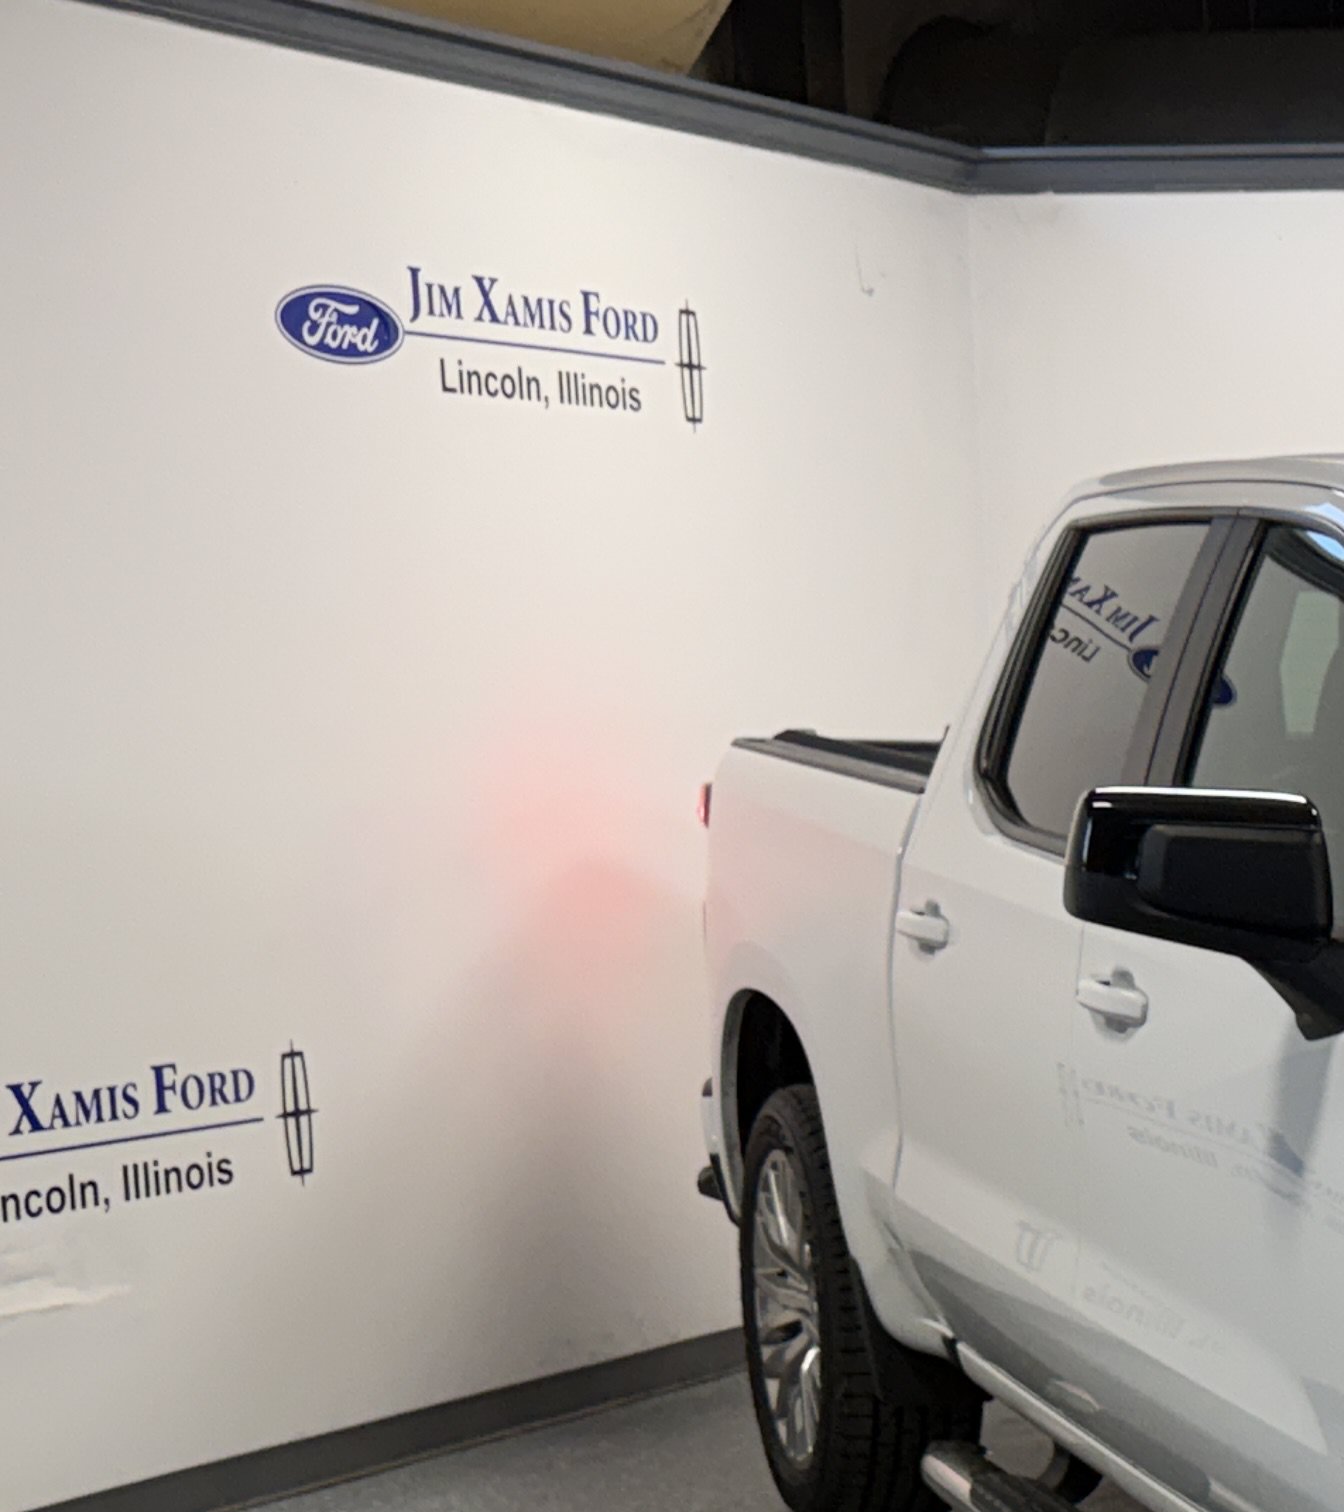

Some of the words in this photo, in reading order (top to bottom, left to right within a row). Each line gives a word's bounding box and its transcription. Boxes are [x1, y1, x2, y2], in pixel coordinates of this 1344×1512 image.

[302, 297, 379, 353] Ford
[407, 266, 462, 323] JIM
[472, 274, 572, 333] XAMIS
[581, 290, 658, 343] FORD
[440, 358, 550, 408] Lincoln,
[557, 369, 642, 413] Illinois
[5, 1080, 140, 1136] XAMIS
[150, 1063, 255, 1116] FORD
[0, 1173, 110, 1224] ncoln,
[122, 1152, 235, 1202] Illinois
